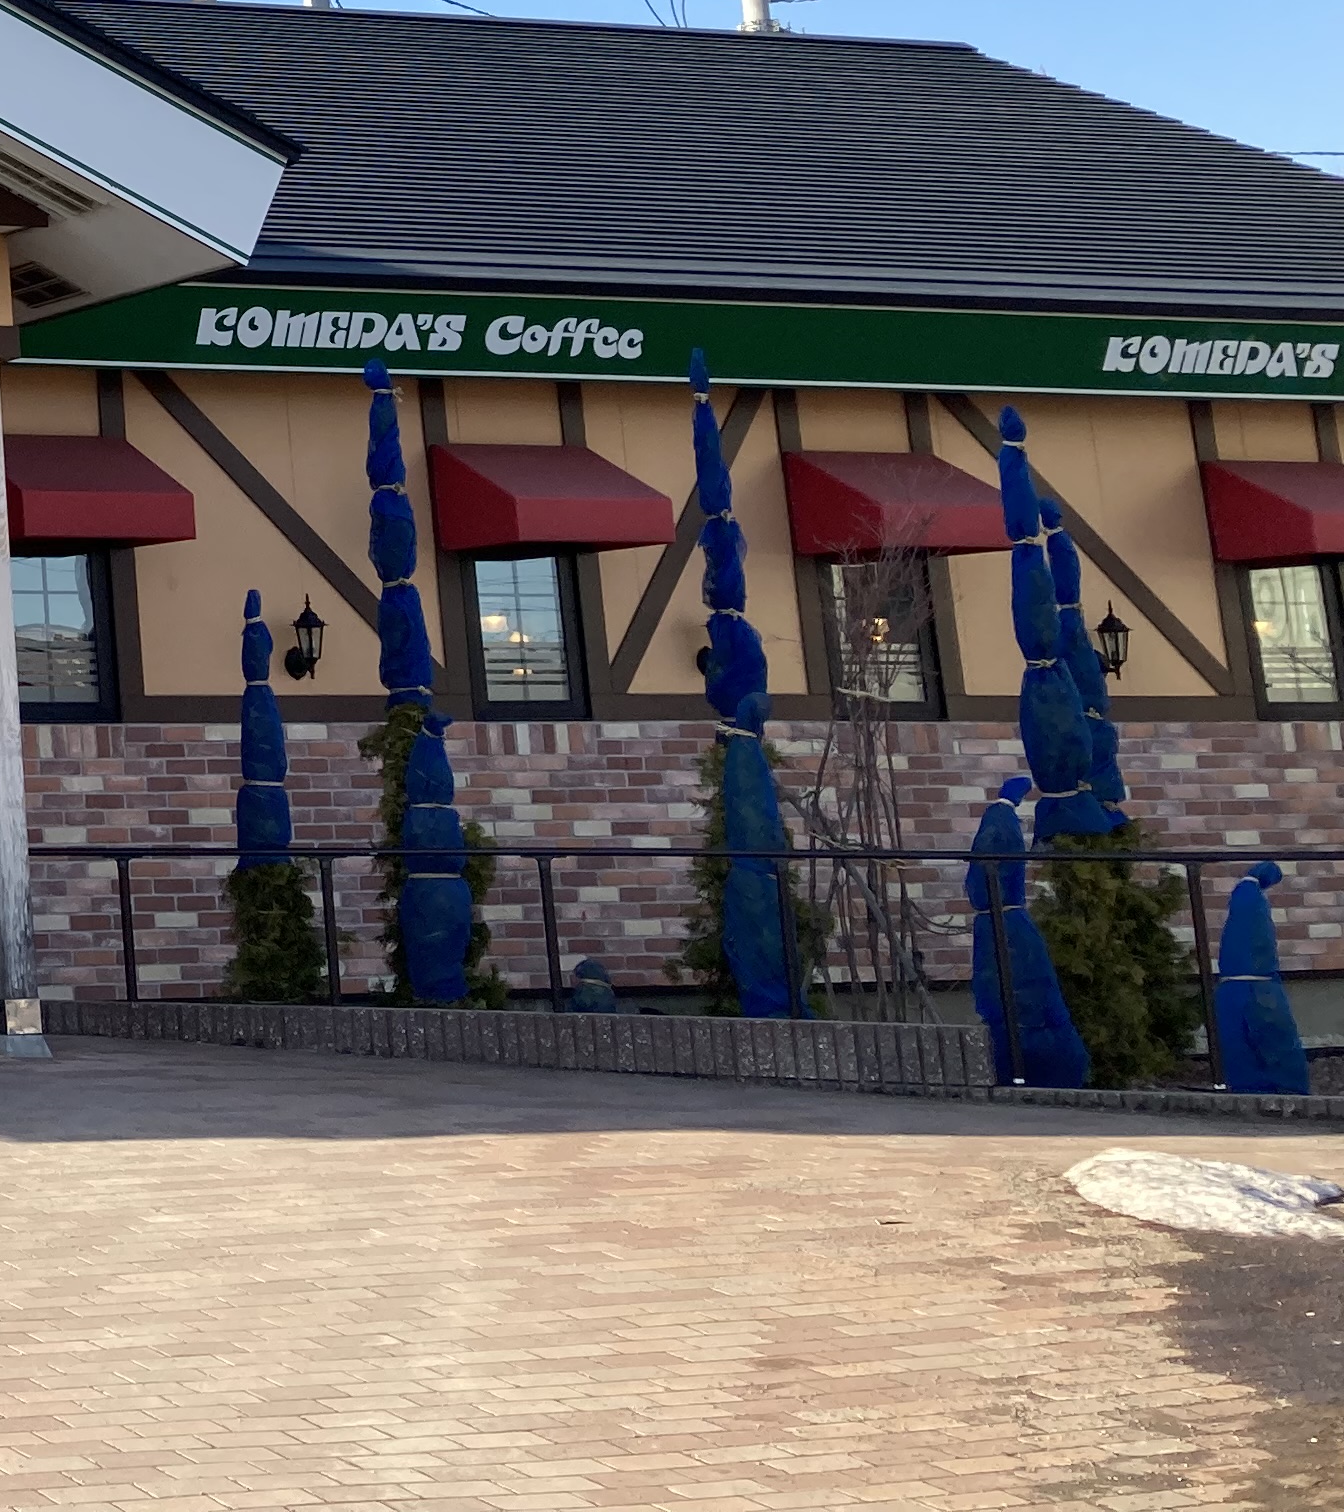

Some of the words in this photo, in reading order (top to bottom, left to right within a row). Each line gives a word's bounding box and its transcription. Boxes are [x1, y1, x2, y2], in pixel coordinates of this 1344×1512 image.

[196, 306, 467, 351] KOMEDA'S
[485, 315, 644, 359] Coffee
[1102, 335, 1340, 378] KOMEDA'S
